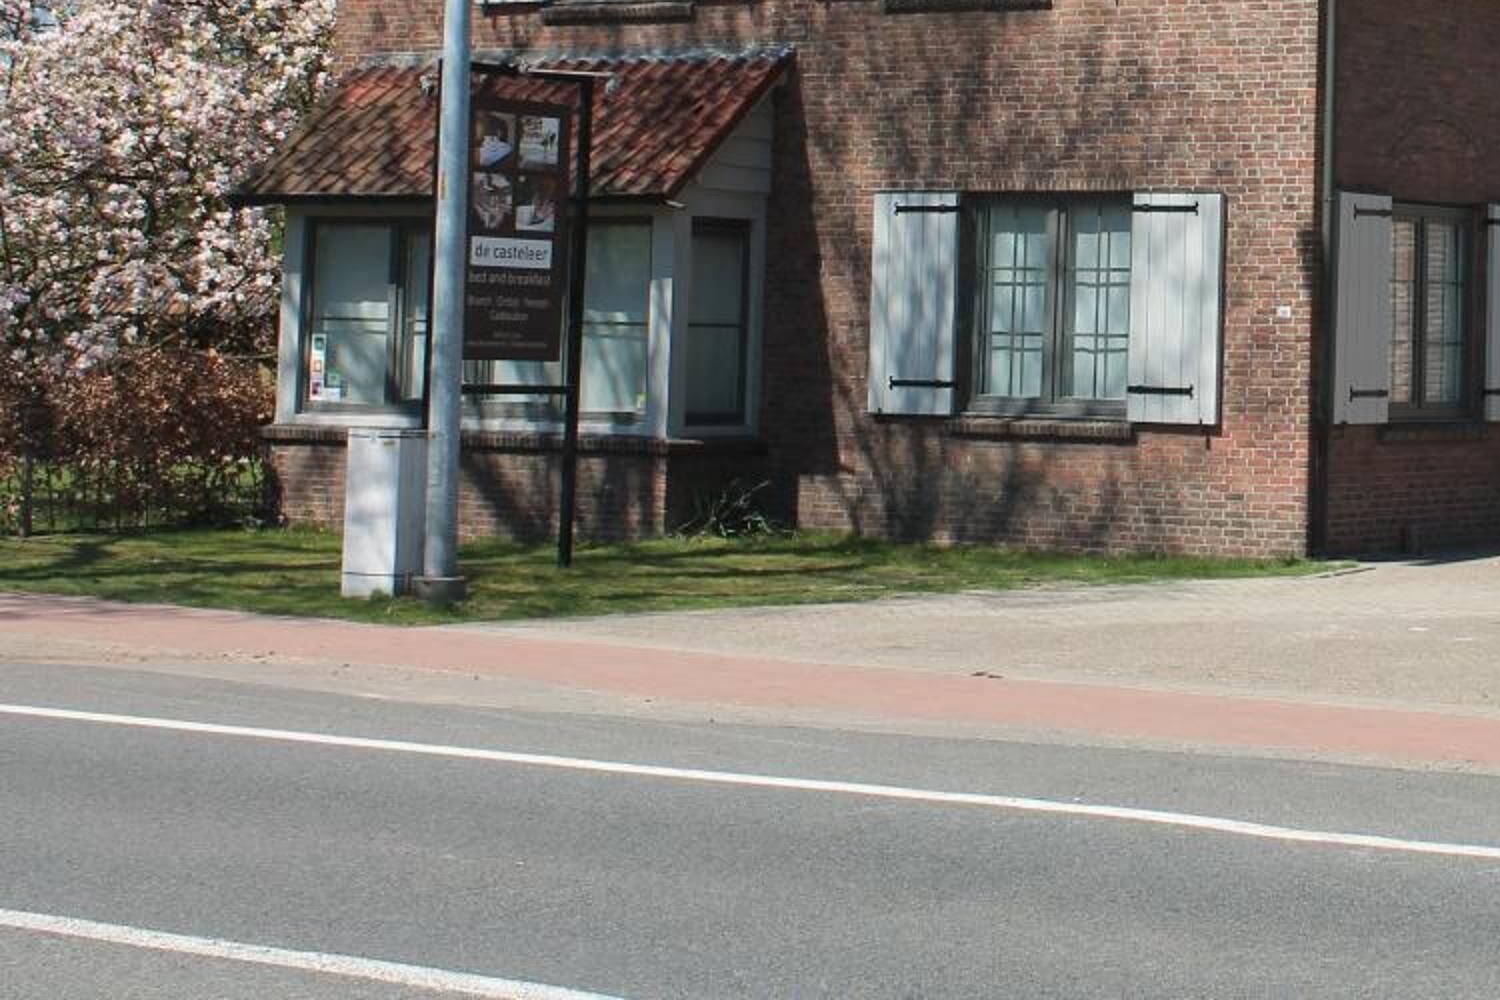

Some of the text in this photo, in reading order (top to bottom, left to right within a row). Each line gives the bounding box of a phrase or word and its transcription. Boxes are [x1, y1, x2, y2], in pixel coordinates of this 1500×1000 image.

[475, 244, 549, 261] de casteleer
[469, 271, 552, 286] bed and breakfast
